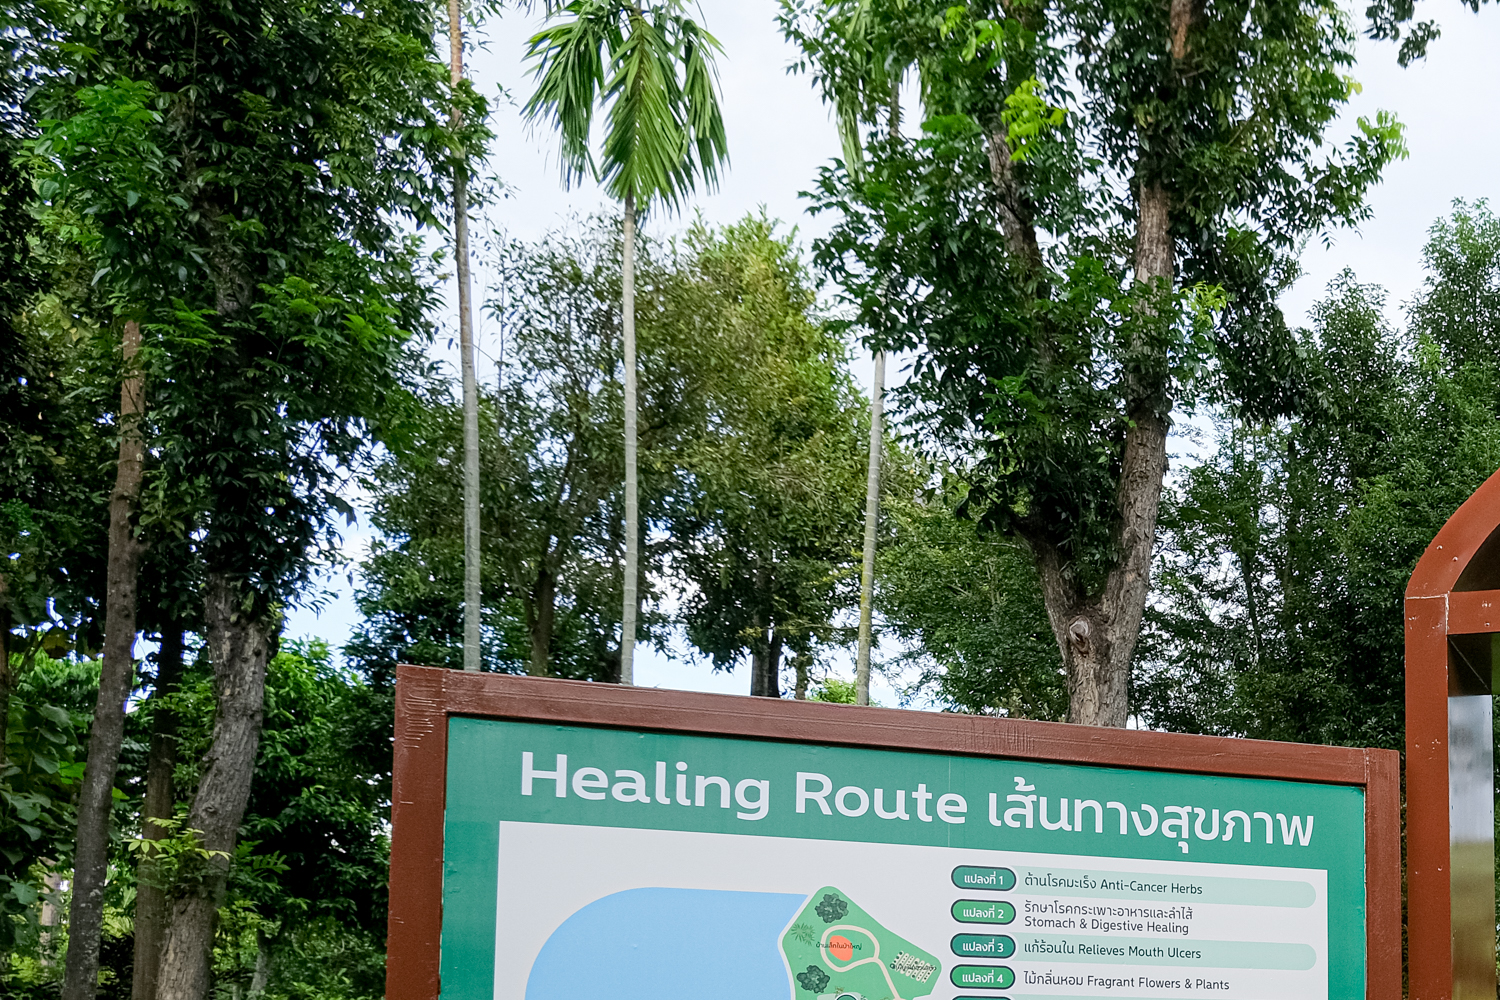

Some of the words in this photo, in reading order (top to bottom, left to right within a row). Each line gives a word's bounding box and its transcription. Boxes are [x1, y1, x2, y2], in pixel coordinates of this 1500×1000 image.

[521, 752, 769, 820] Healing
[796, 772, 967, 823] Route
[989, 777, 1313, 853] เส้นทางสุขภาพ
[964, 870, 996, 884] แปลงที่
[999, 875, 1003, 885] 1
[1024, 871, 1097, 889] ต้านโรคมะเร็ง
[1100, 878, 1167, 893] Anti-Cancer
[1171, 882, 1203, 895] Herbs
[1024, 915, 1075, 928] Stomach
[1079, 917, 1087, 929] &
[1091, 918, 1143, 933] Digestive
[1146, 921, 1189, 936] Healing
[1024, 938, 1075, 954] แก้ร้อนใน
[1078, 943, 1125, 956] Relieves
[1128, 945, 1164, 957] Mouth
[1167, 947, 1201, 959] Ulcers
[1023, 969, 1083, 986] ไม้กลิ่นหอม
[1087, 975, 1135, 989] Fragrant
[1138, 976, 1181, 989] Flowers
[1184, 978, 1192, 989] &
[1195, 978, 1229, 990] Plants
